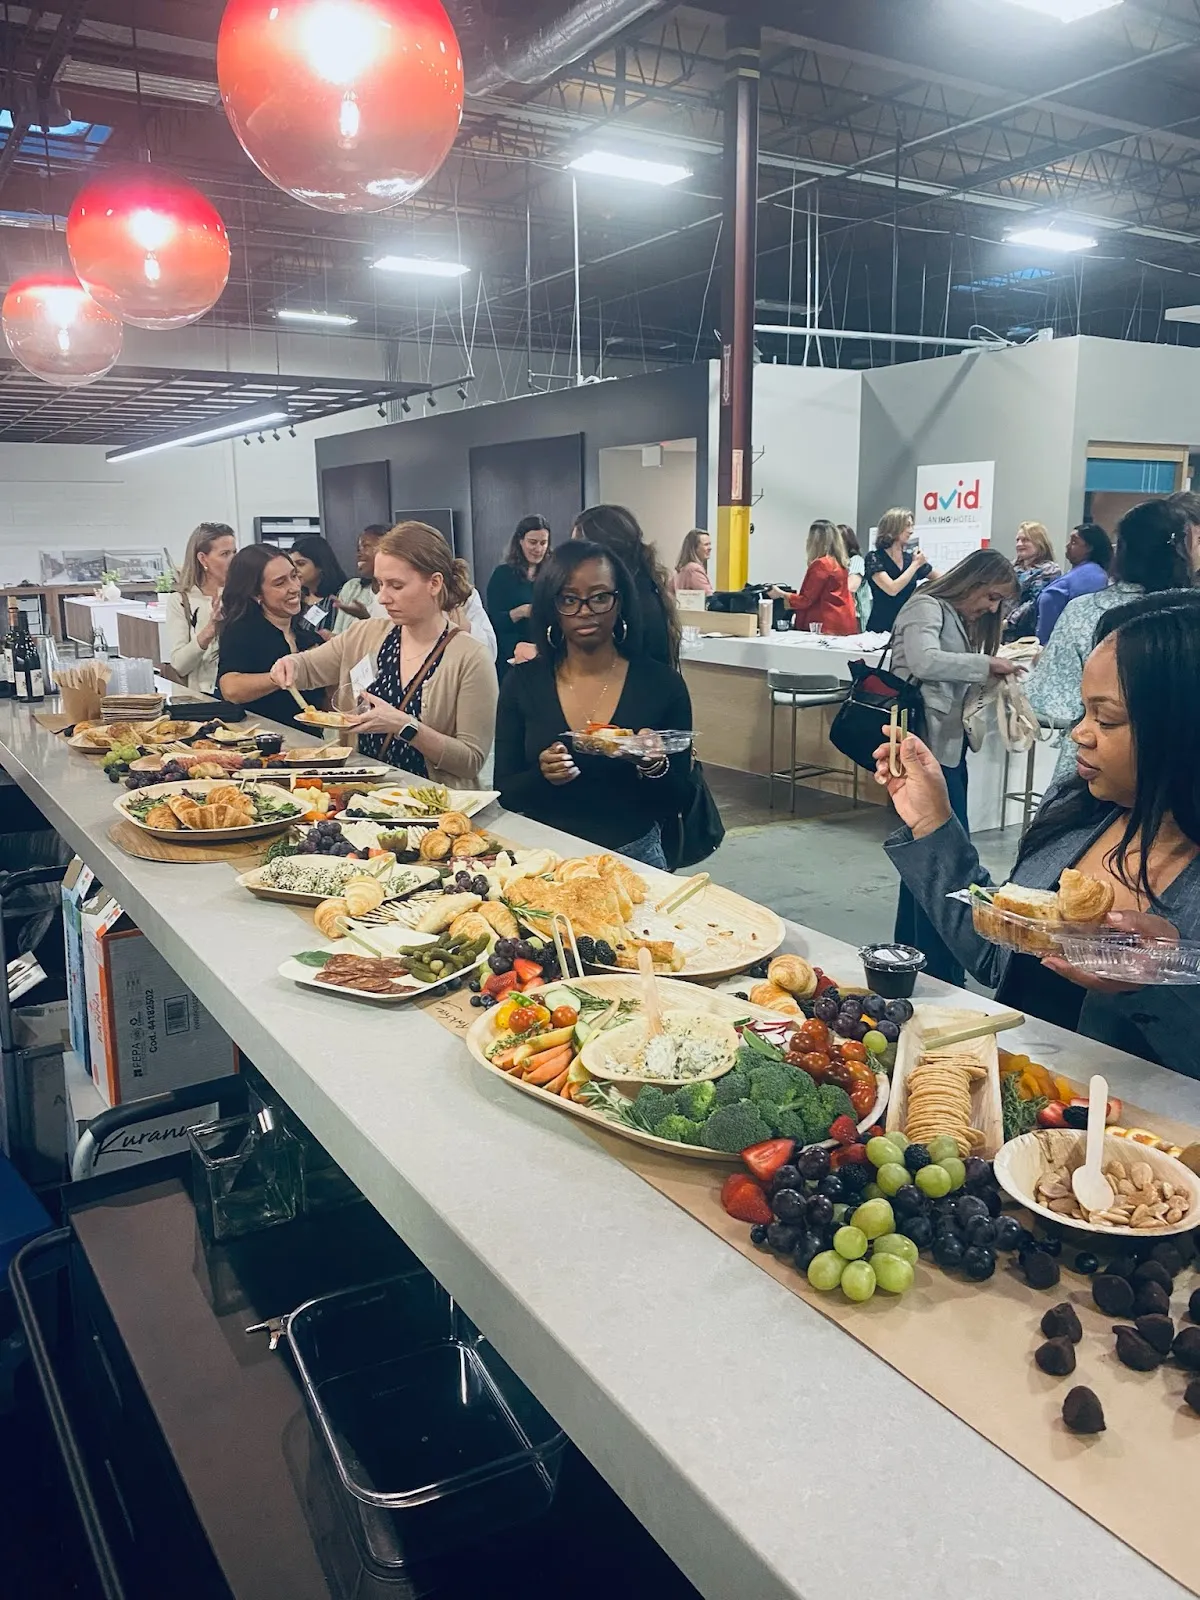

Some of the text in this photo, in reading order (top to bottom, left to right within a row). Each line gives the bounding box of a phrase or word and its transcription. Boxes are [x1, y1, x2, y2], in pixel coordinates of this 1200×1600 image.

[923, 479, 980, 511] avid
[953, 515, 976, 523] HOTEL
[132, 1043, 143, 1068] FEPA
